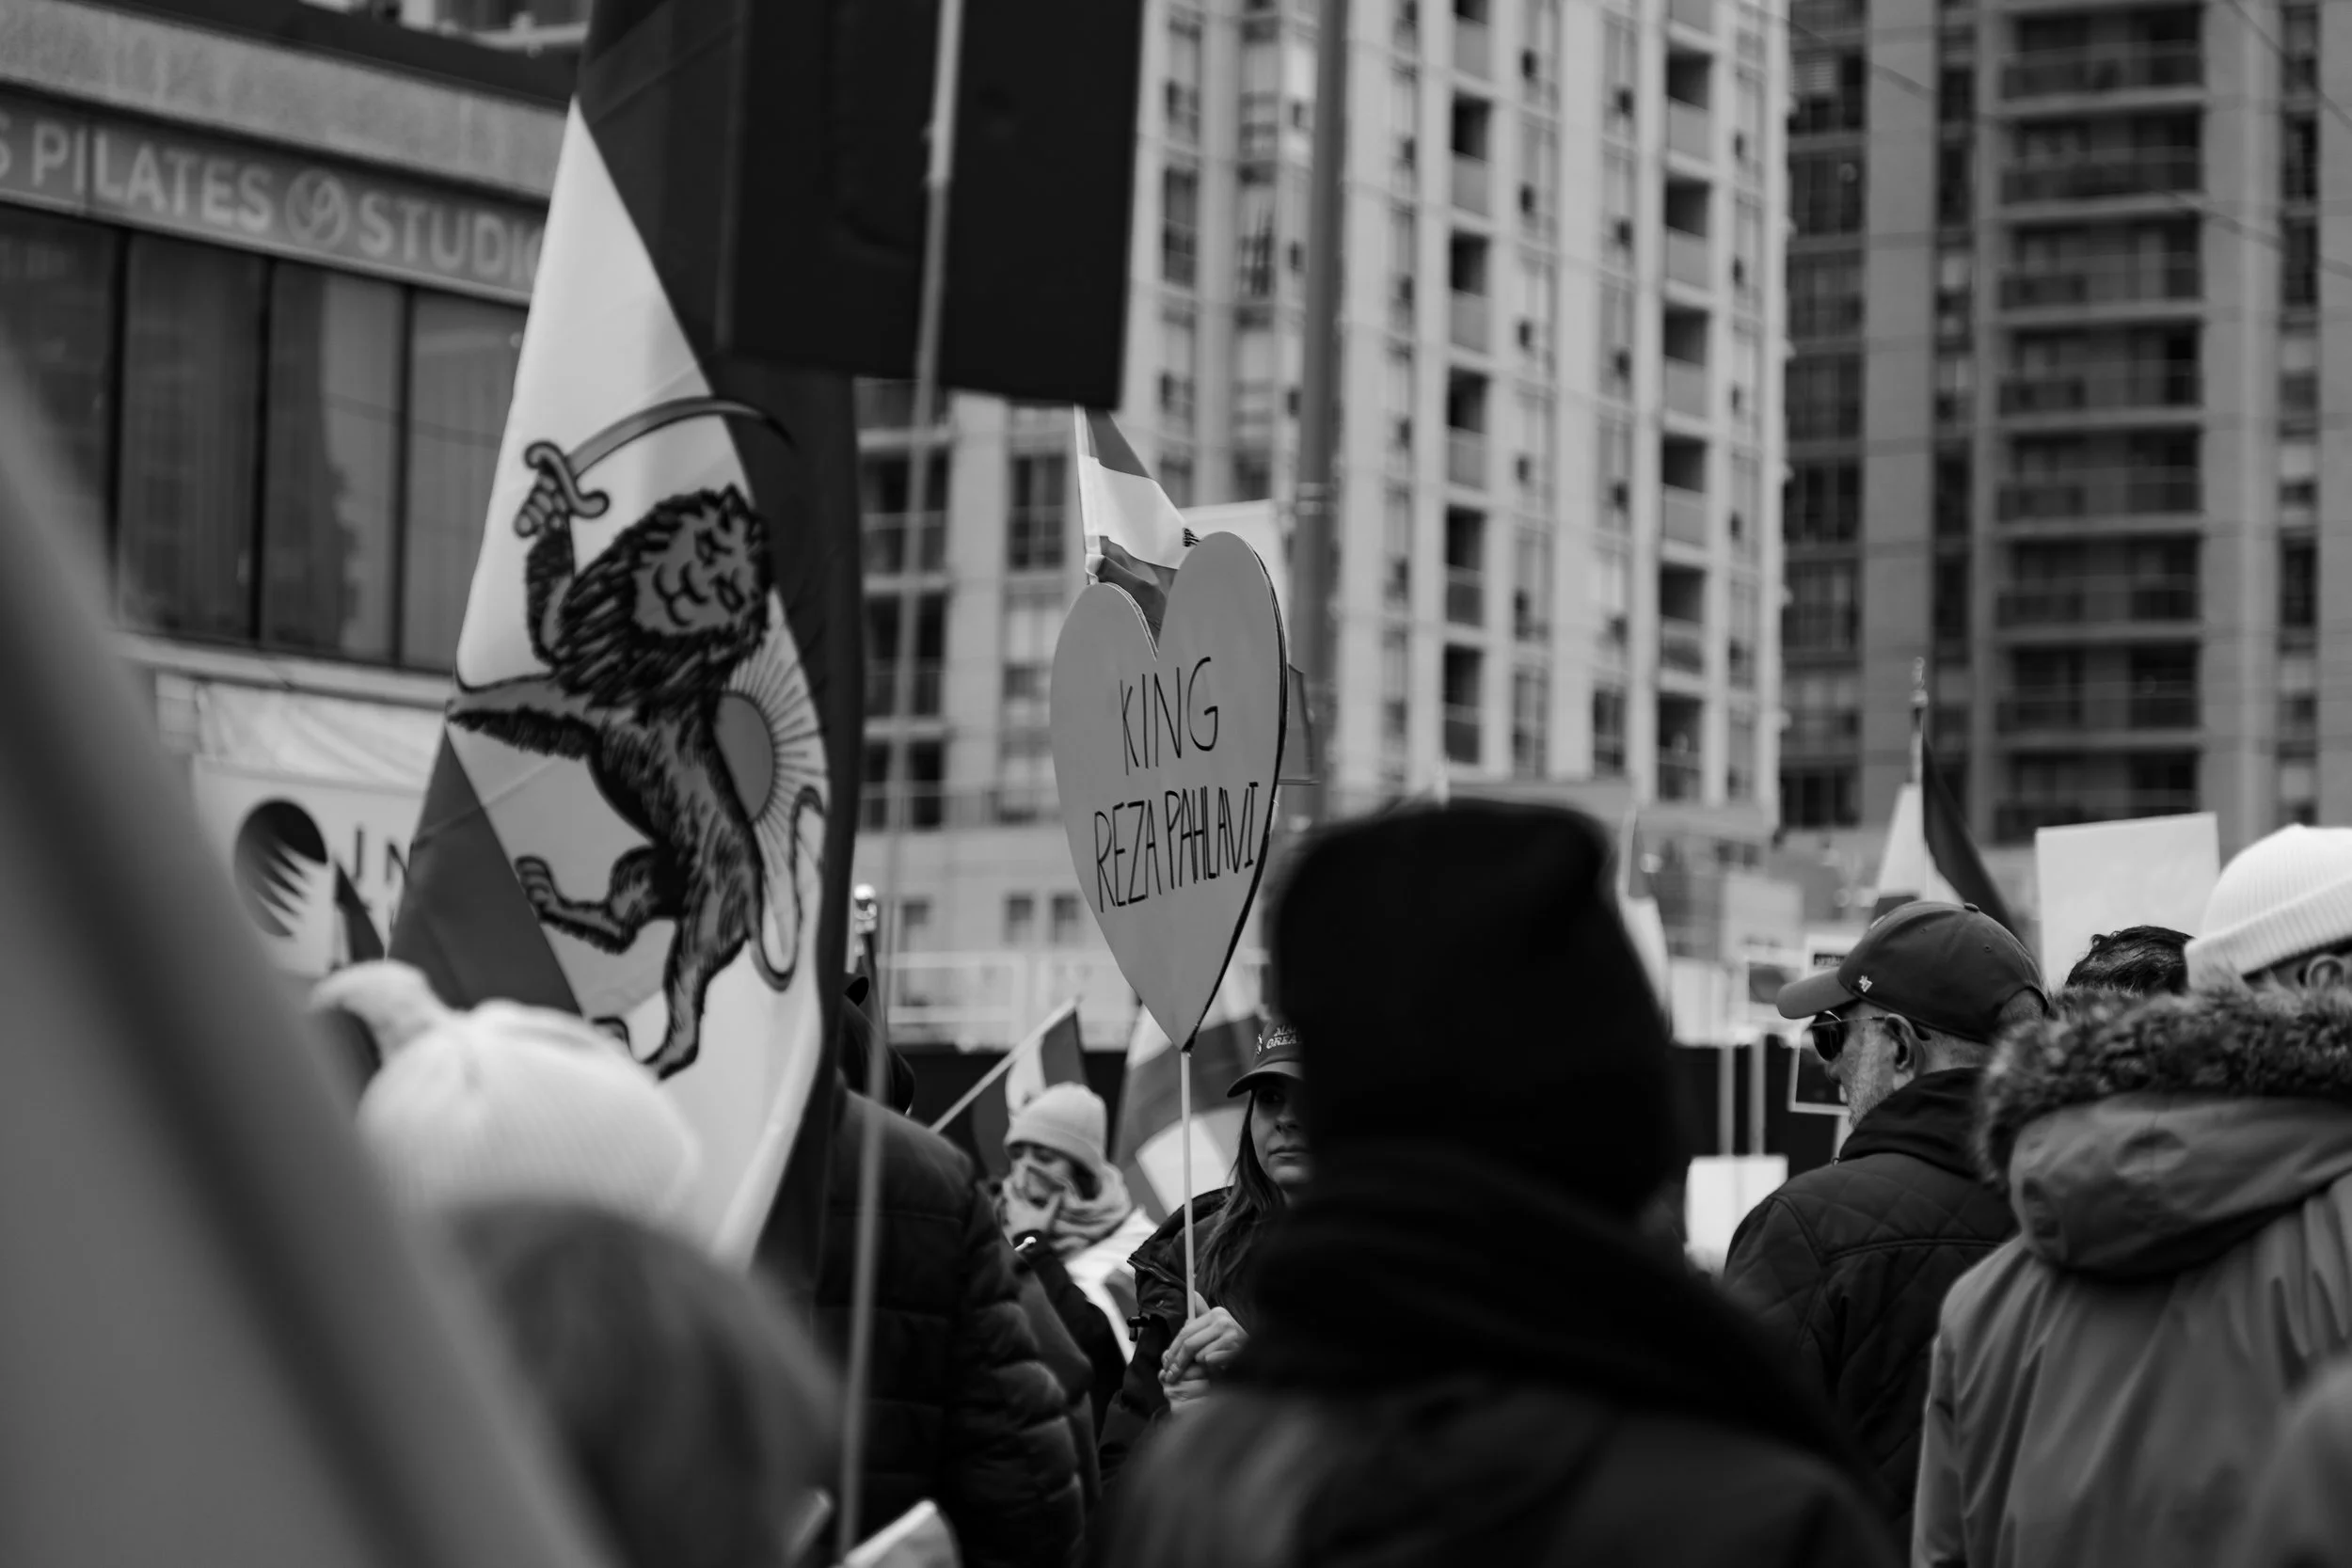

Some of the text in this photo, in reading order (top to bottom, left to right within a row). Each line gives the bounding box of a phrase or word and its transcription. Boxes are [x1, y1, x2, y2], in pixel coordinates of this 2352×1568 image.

[32, 119, 274, 232] PILATES
[1120, 656, 1219, 776] KING
[1094, 782, 1259, 914] REZA PAHLAVI
